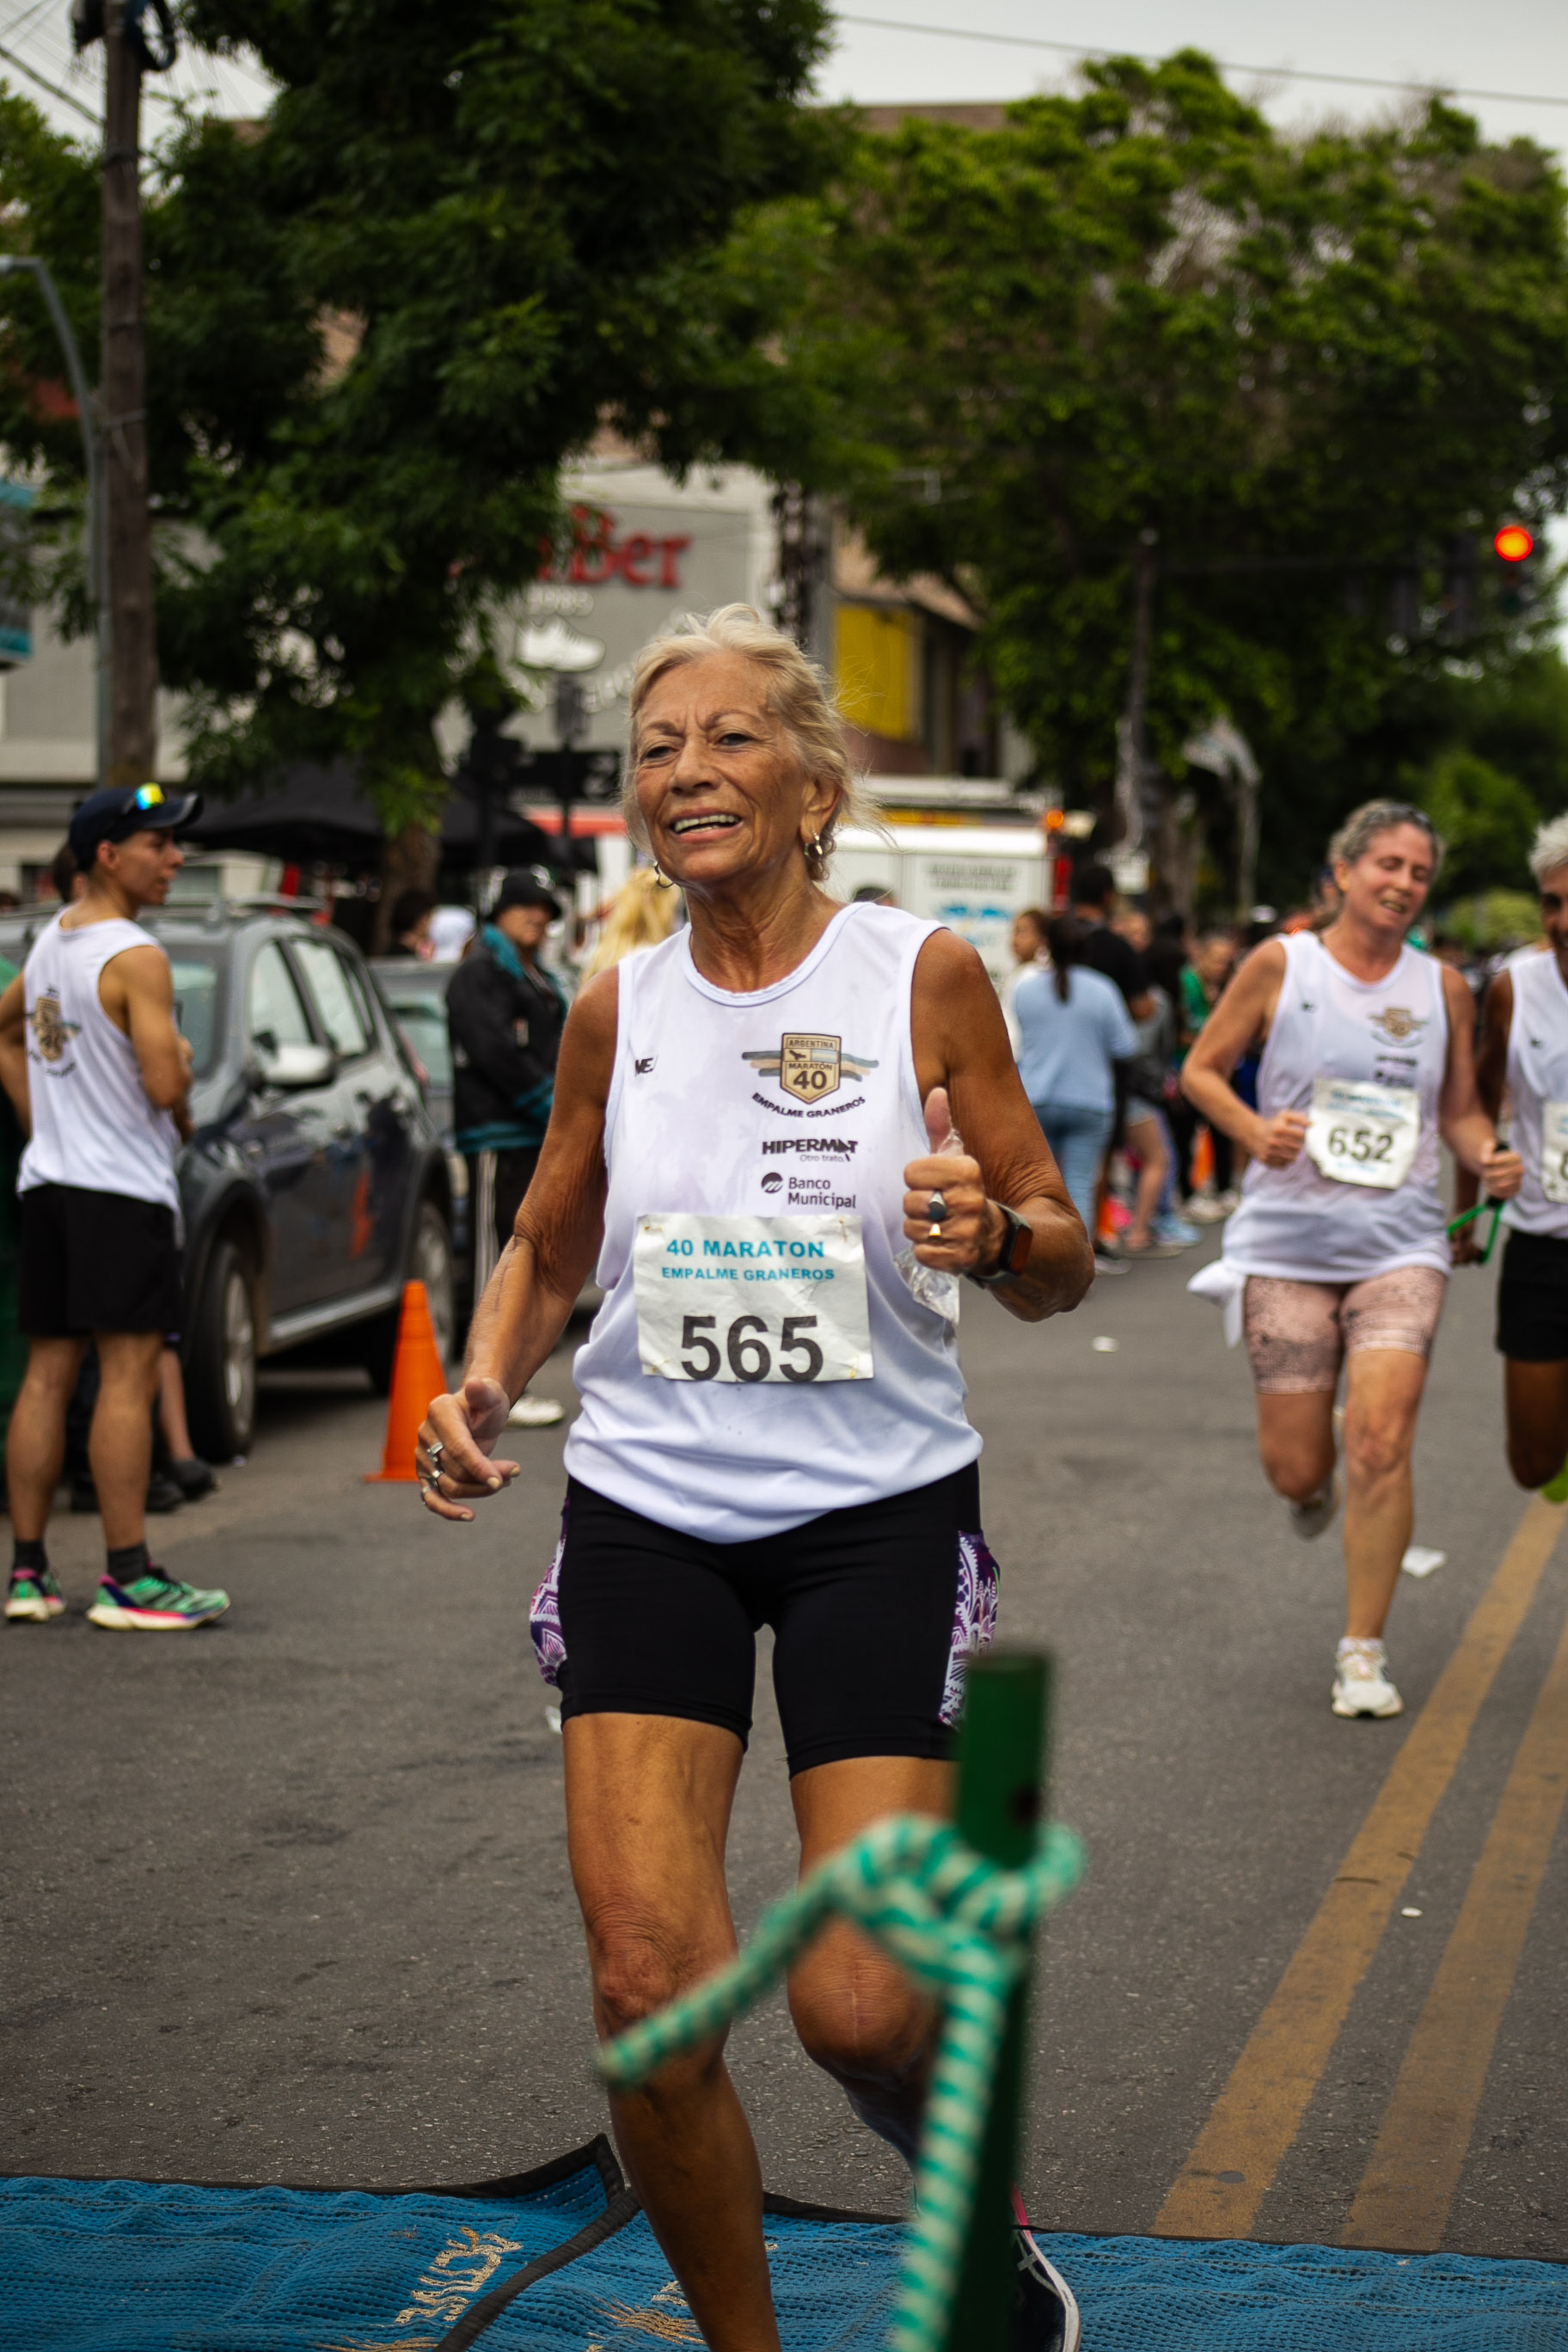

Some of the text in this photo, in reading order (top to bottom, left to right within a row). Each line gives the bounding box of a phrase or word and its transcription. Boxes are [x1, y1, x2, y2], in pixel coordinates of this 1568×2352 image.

[788, 1039, 835, 1049] ARGENTINA
[793, 1071, 827, 1089] 40
[751, 1092, 866, 1118] EMPALME GRANEROS
[1327, 1127, 1393, 1163] 652
[799, 1154, 820, 1162] Otro
[788, 1177, 831, 1190] Banco
[787, 1192, 856, 1210] Municipal
[666, 1239, 825, 1259] 40 MARATON
[661, 1266, 836, 1282] EMPALME GRANEROS
[680, 1314, 824, 1382] 565
